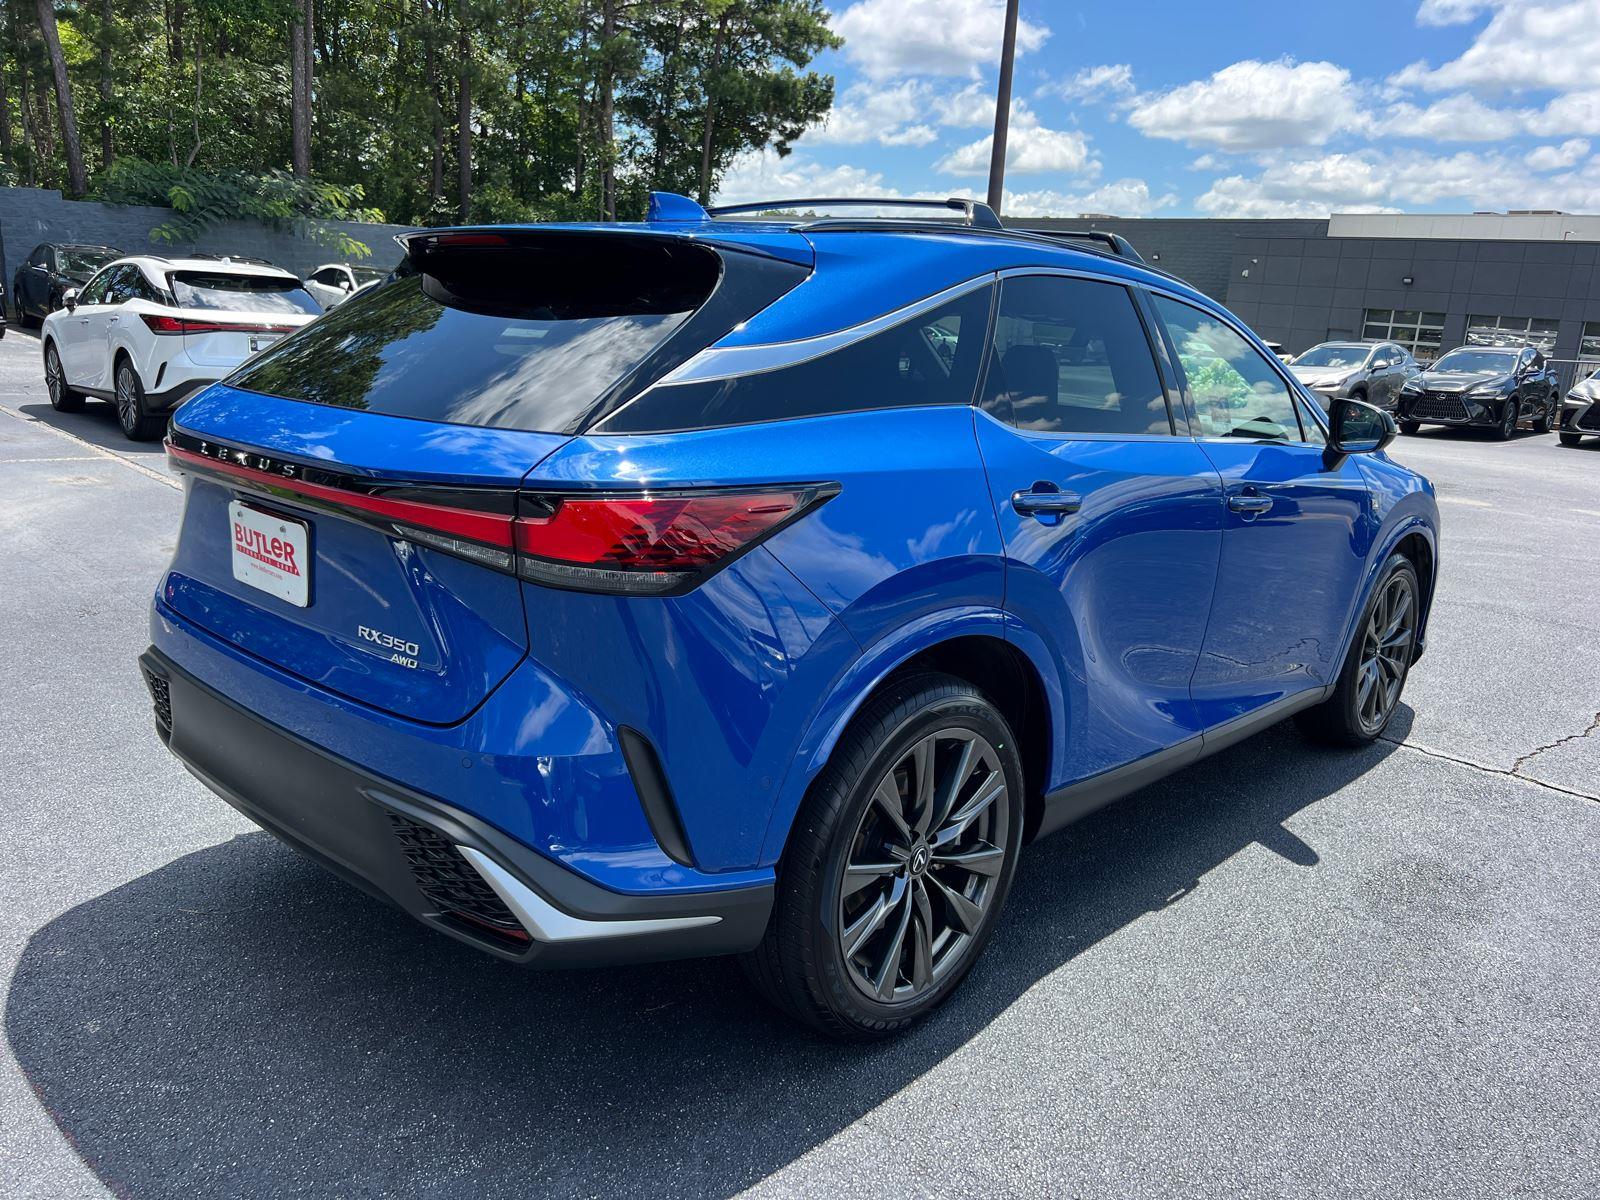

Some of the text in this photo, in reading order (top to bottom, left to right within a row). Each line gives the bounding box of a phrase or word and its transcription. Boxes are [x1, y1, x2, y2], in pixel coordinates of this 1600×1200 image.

[200, 441, 296, 477] LEXUS
[358, 624, 419, 656] RX350
[391, 653, 418, 669] AWD
